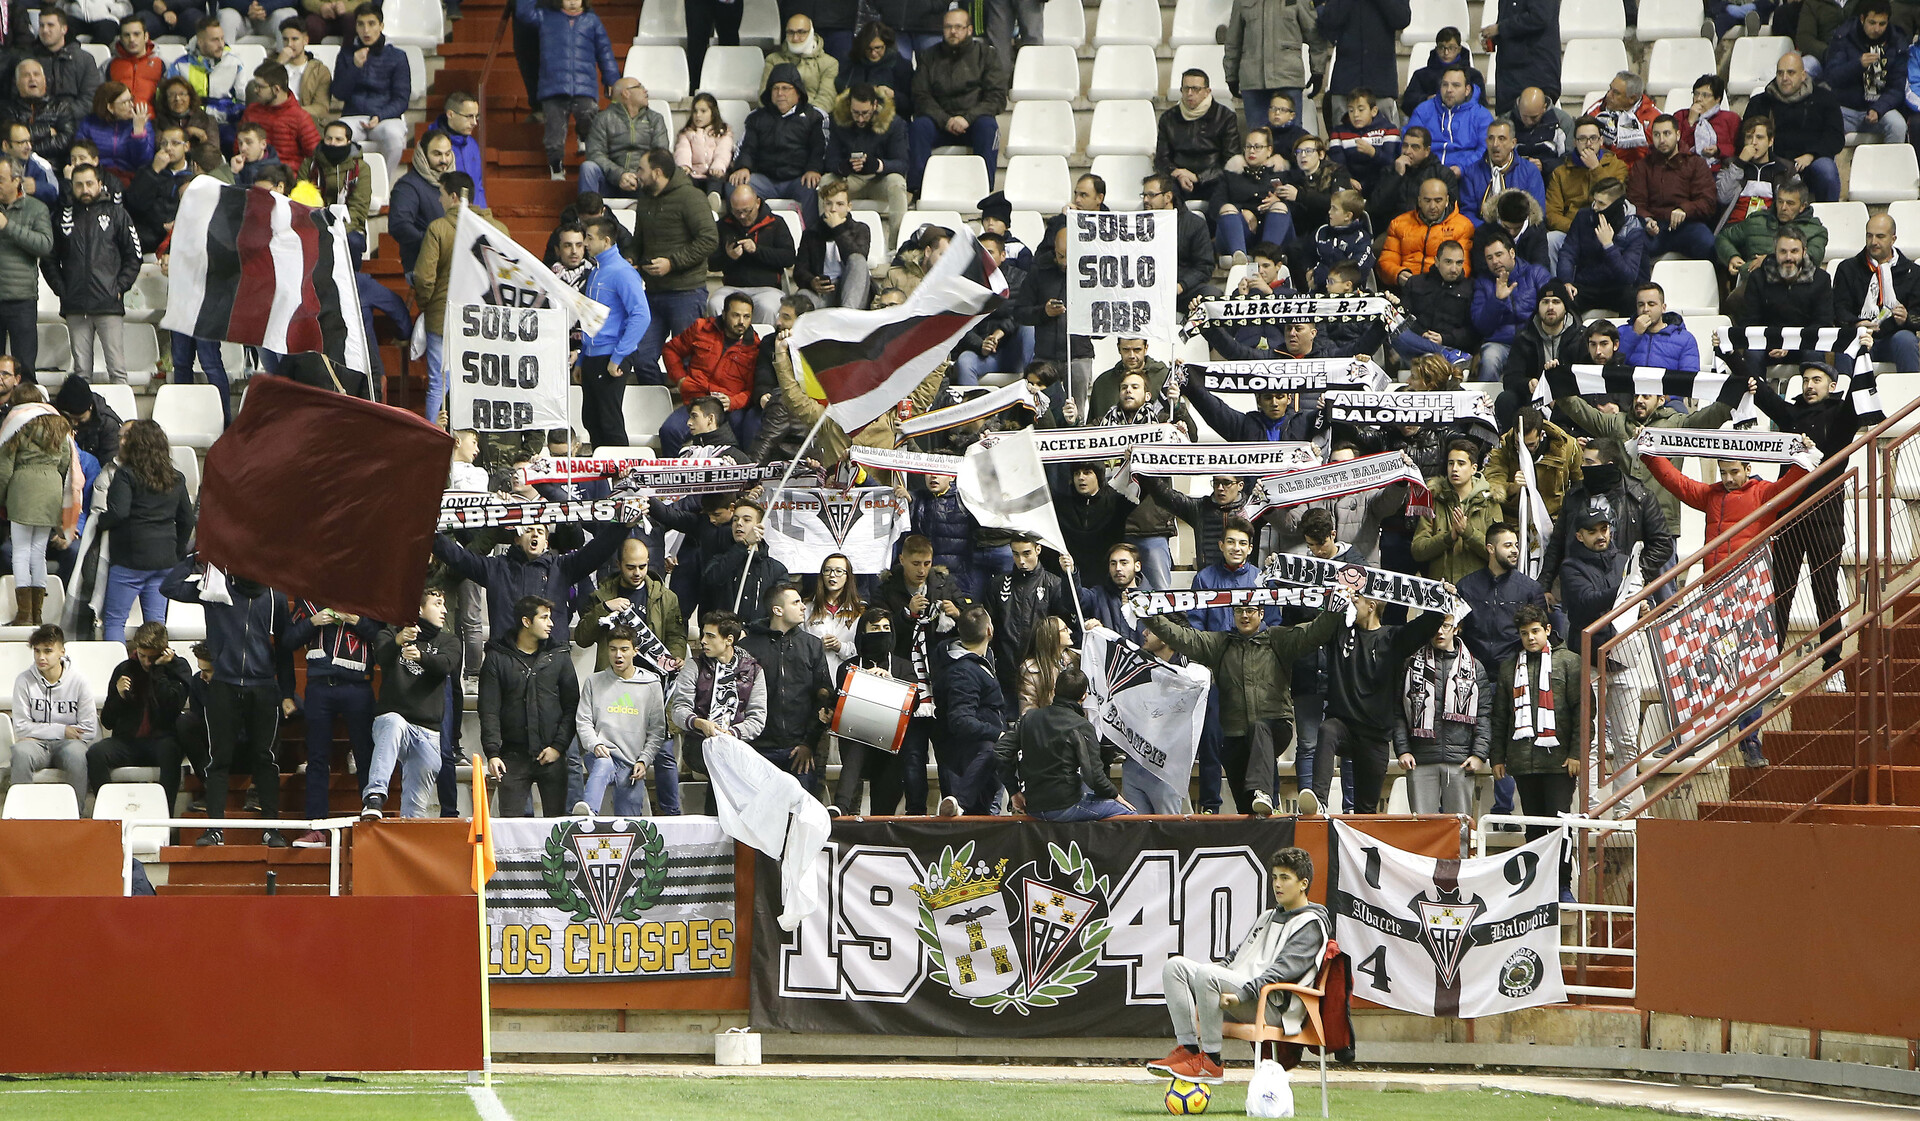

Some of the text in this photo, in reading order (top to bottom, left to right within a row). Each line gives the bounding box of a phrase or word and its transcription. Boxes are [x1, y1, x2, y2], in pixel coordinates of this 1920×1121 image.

[1077, 213, 1155, 242] SOLO
[1078, 255, 1155, 288] SOLO
[1091, 301, 1151, 333] ABP
[1223, 301, 1317, 316] ALBACETE
[462, 304, 538, 342] SOLO
[462, 351, 539, 389] SOLO
[1205, 361, 1326, 376] ALBACETE
[1204, 373, 1327, 390] BALOMPIÉ
[1332, 393, 1454, 408] ALBACETE
[472, 398, 533, 429] ABP
[1331, 405, 1455, 423] BALOMPIÉ
[1035, 429, 1164, 451] ACETE BALOMPIÉ
[1660, 435, 1783, 453] ALBACETE BALOMPIÉ
[556, 459, 616, 474] ALBACETE
[1131, 449, 1284, 466] ALBACETE BALOMPIÉ
[711, 466, 775, 483] ALBACETE
[1278, 457, 1405, 494] ALBACETE BALOM
[437, 500, 617, 531] ABP FANS
[1270, 554, 1446, 609] ABP FANS
[1148, 587, 1325, 616] ABP FANS
[30, 697, 79, 714] EVER
[607, 704, 639, 716] adidas
[1351, 899, 1550, 944] Albacete Balompié
[486, 918, 734, 975] LOS CHOSPES
